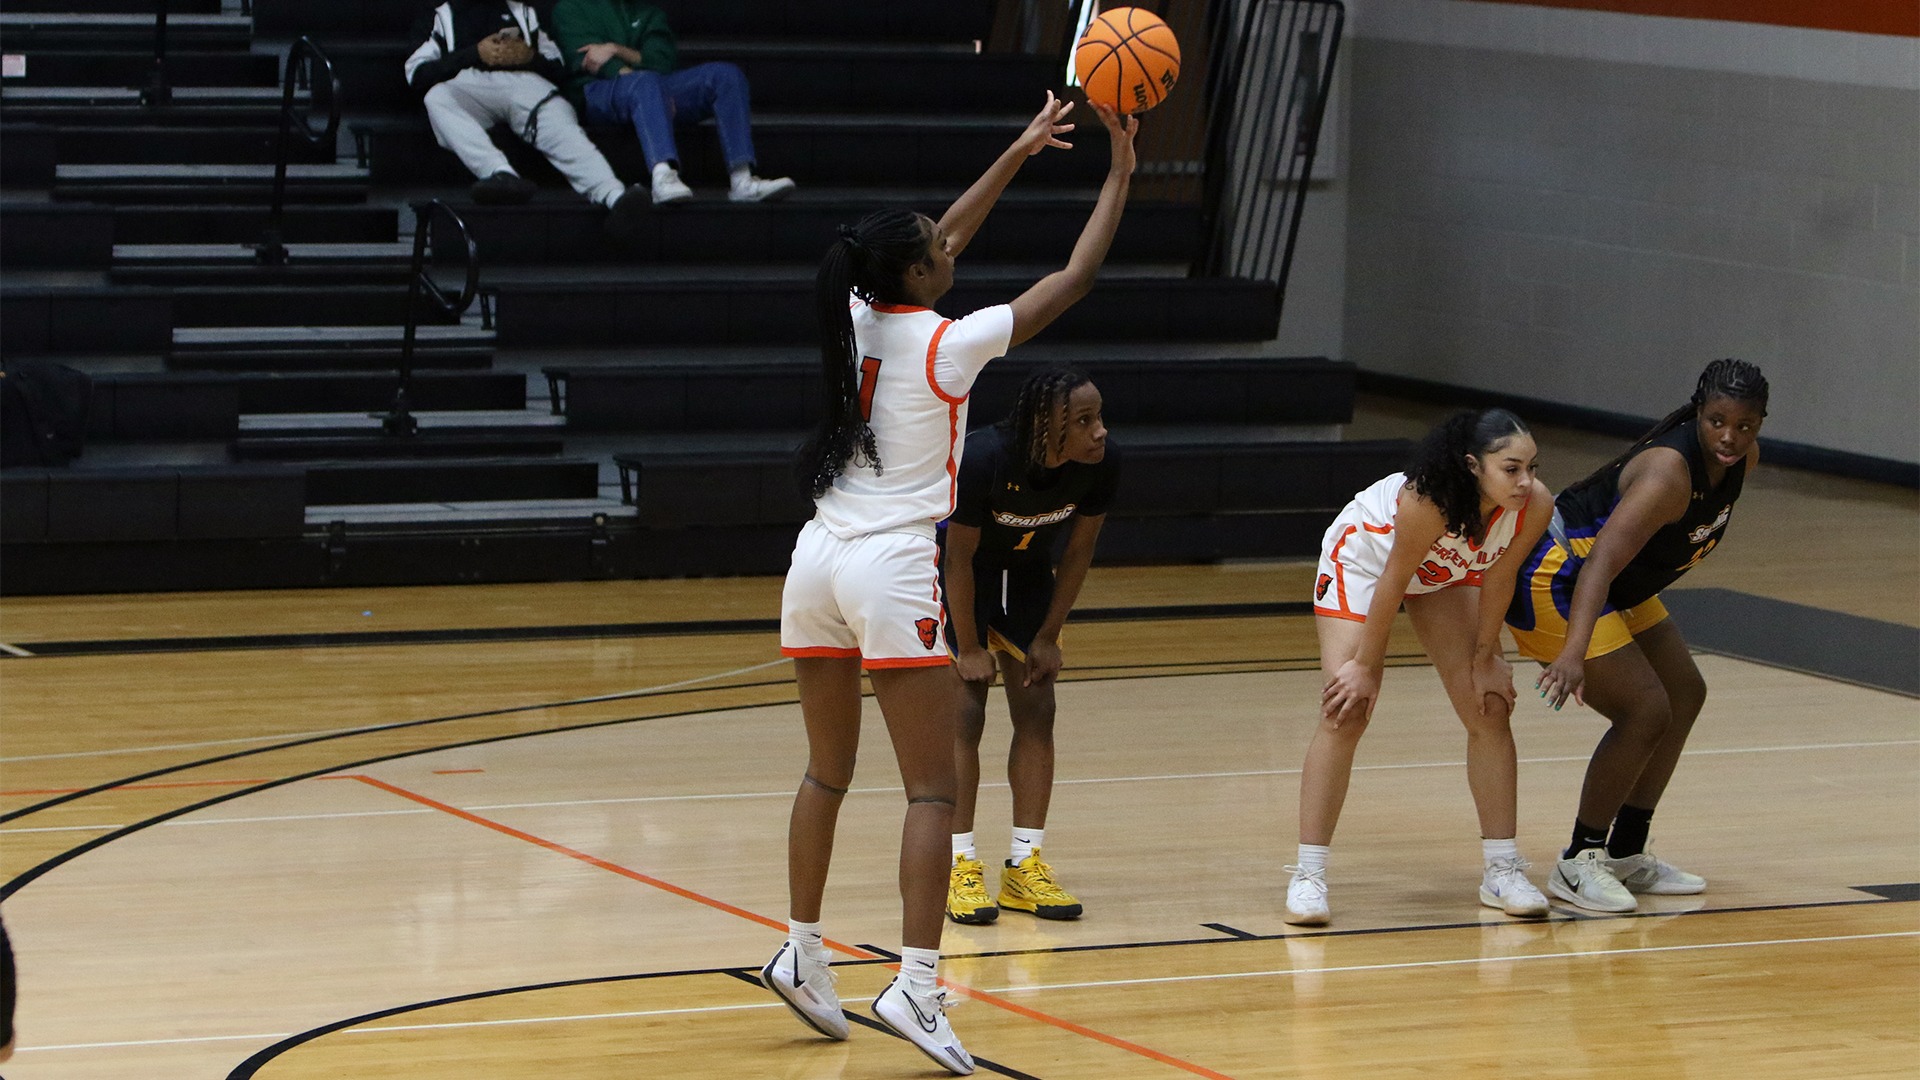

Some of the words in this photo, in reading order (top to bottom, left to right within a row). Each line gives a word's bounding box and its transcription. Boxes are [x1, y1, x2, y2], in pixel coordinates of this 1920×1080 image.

[859, 355, 882, 423] 1
[994, 504, 1076, 528] SPALDING
[1013, 531, 1036, 550] 1
